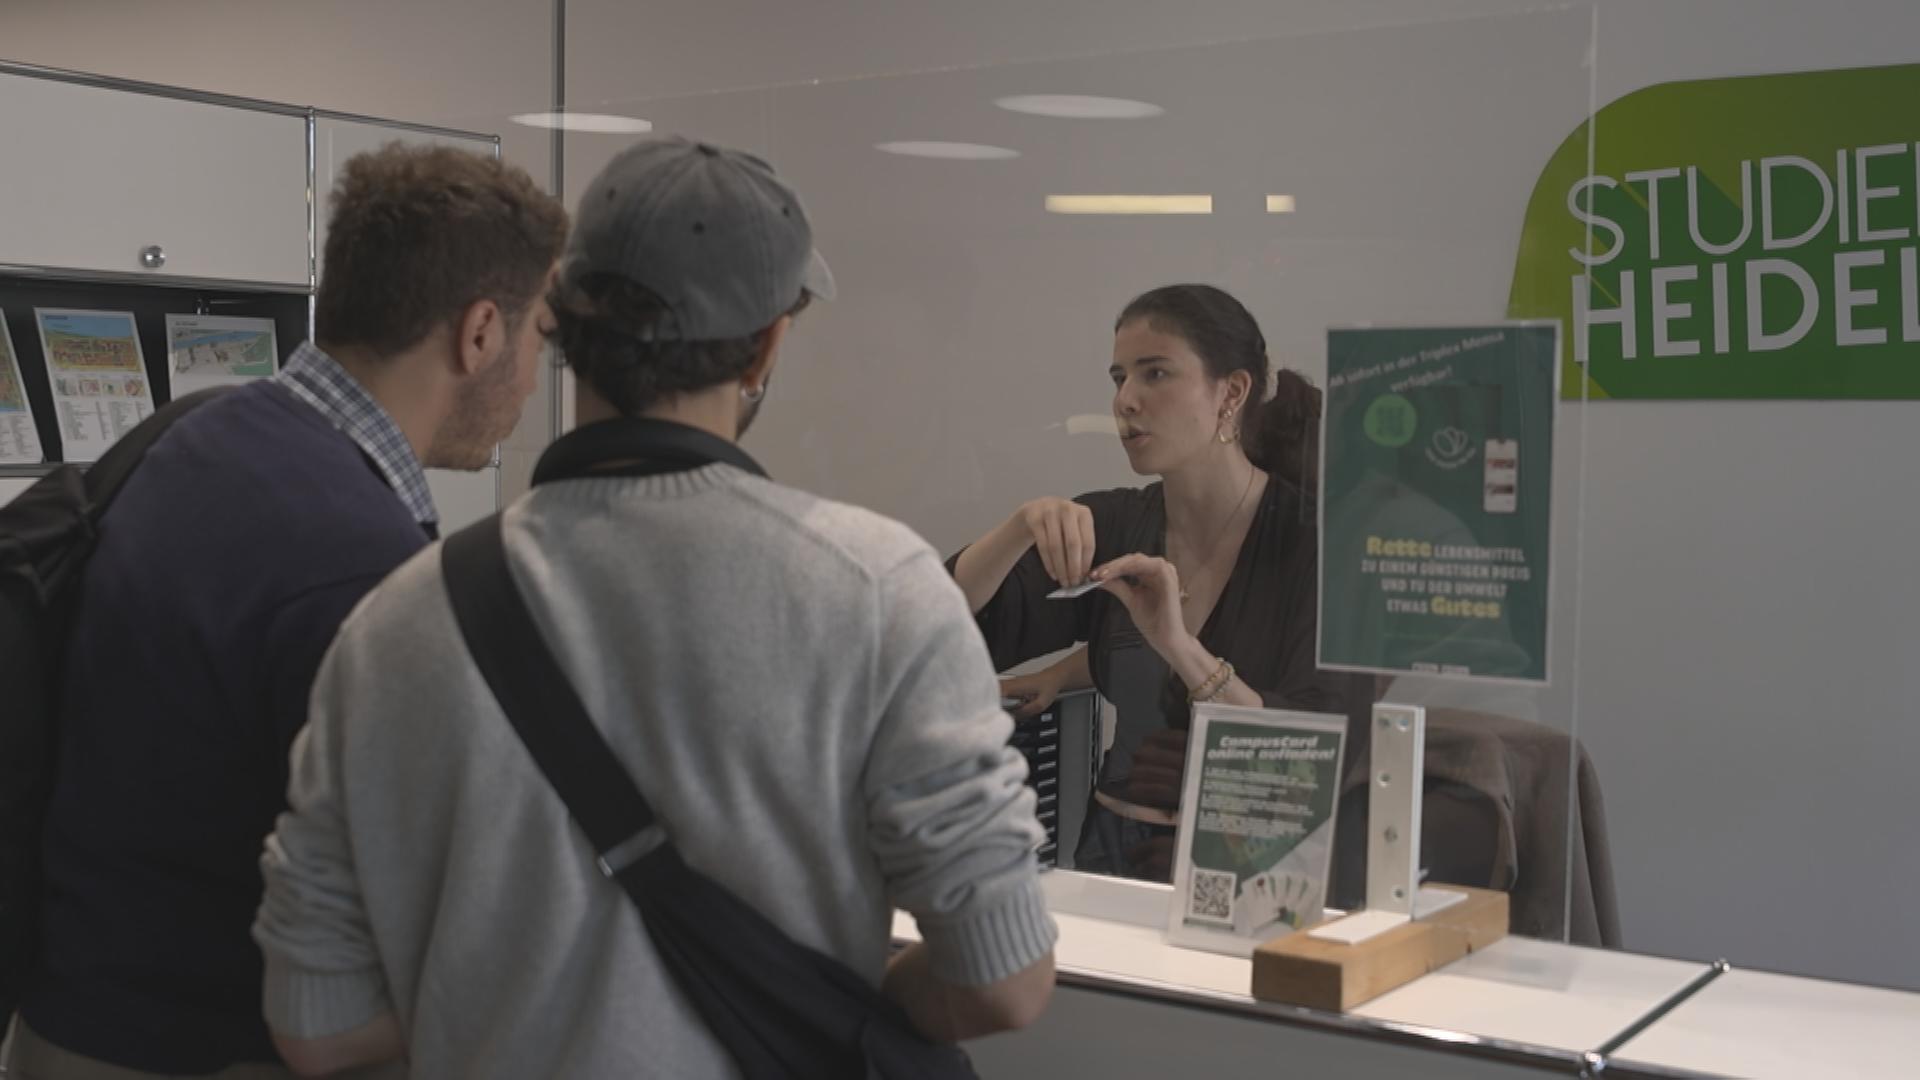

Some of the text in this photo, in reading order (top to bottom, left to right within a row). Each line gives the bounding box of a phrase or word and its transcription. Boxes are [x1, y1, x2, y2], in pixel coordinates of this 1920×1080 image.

[1567, 141, 1920, 266] STUDIE
[1347, 365, 1381, 382] sofort
[1398, 355, 1417, 368] der
[1462, 331, 1504, 350] Mensa
[1366, 535, 1525, 562] Rette LEBENSMITTEL
[1361, 559, 1531, 581] ZU EINEM GÜNSTIGEN PREIS
[1381, 577, 1407, 592] UND
[1428, 580, 1453, 595] DER
[1455, 582, 1507, 598] UMWELT
[1386, 595, 1500, 618] ETWAS Gutes
[1207, 747, 1255, 760] online
[1220, 735, 1319, 750] CampusCard
